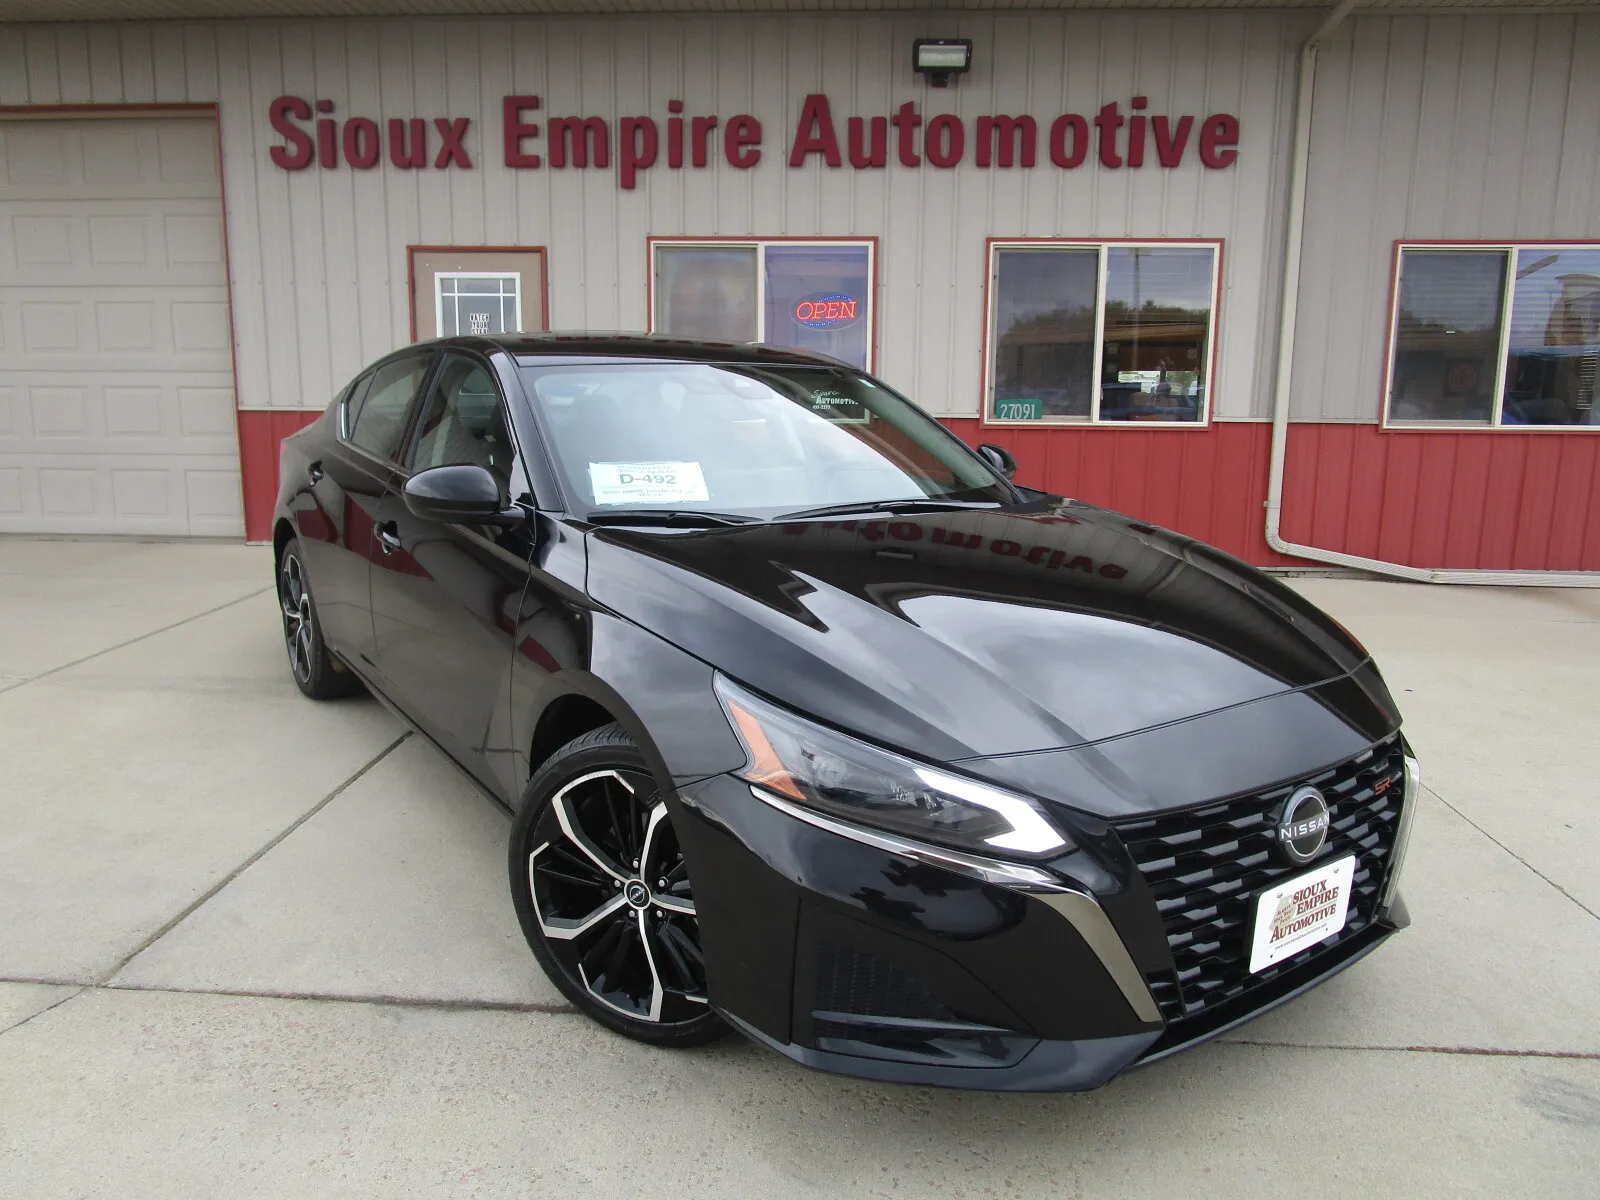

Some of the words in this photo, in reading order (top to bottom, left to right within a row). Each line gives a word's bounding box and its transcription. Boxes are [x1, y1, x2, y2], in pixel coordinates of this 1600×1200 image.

[268, 95, 473, 171] Sioux
[502, 95, 763, 190] Empire
[788, 93, 1241, 169] Automotive
[796, 300, 857, 320] OPEN
[1000, 403, 1035, 420] 27091
[619, 473, 677, 484] D-492
[1373, 776, 1391, 796] SR
[1281, 812, 1329, 840] NISSAN
[1292, 879, 1328, 905] SIOUX
[1297, 886, 1340, 916] EMPIRE
[1269, 903, 1337, 944] AUTOMOTIVE
